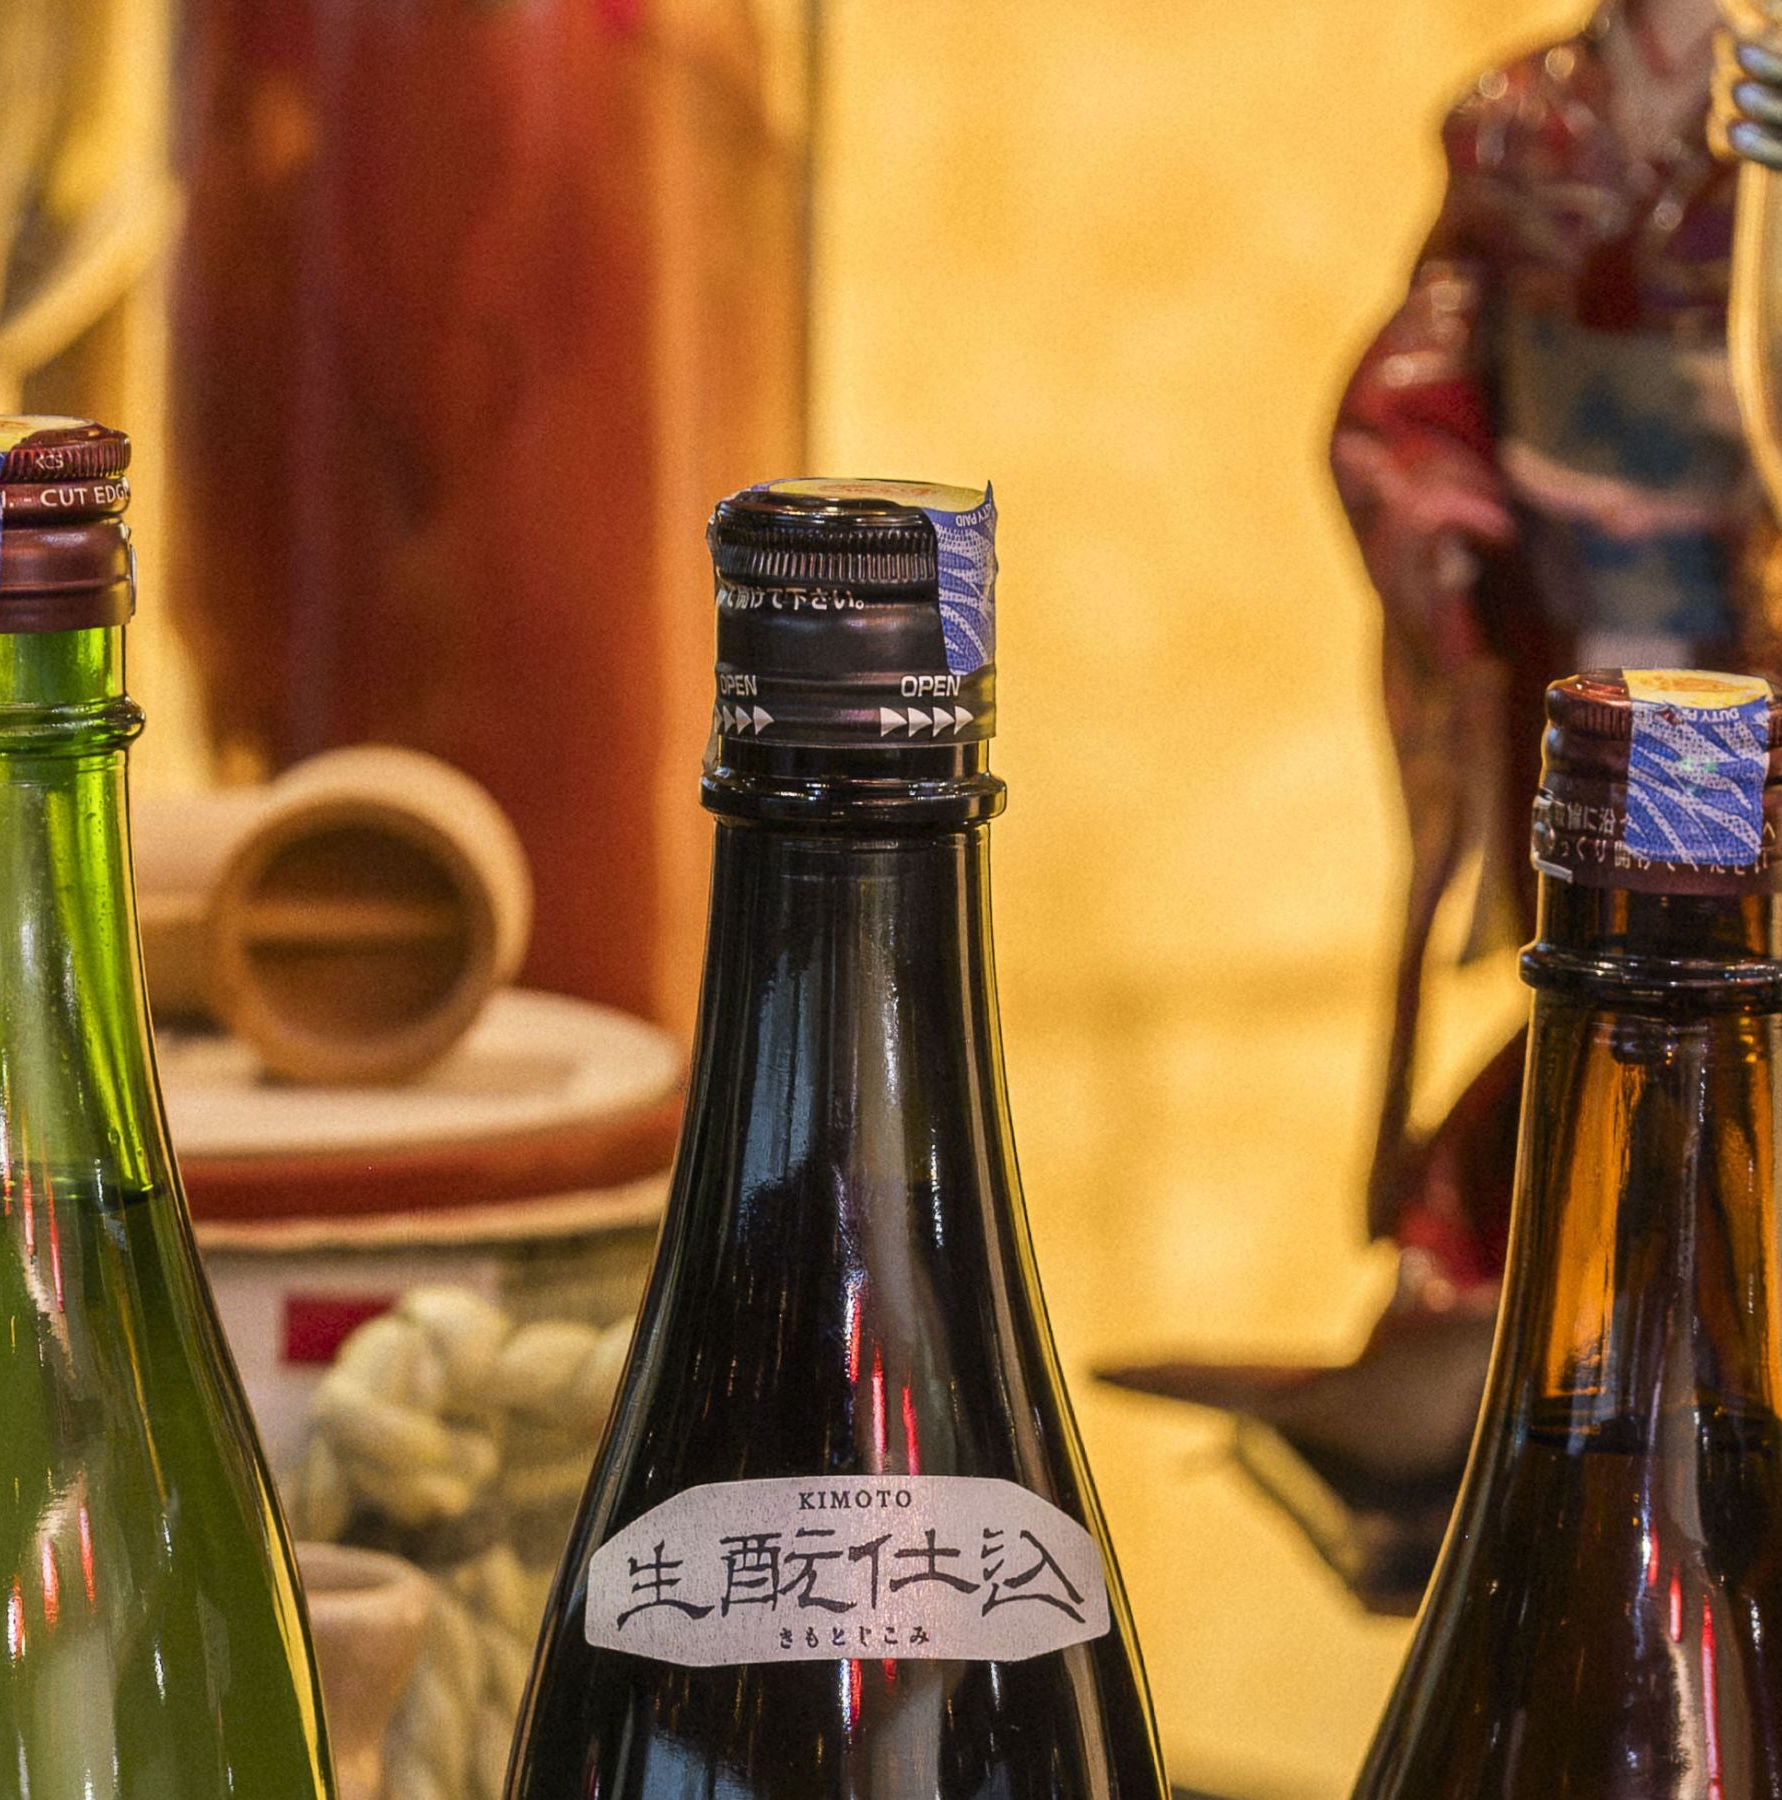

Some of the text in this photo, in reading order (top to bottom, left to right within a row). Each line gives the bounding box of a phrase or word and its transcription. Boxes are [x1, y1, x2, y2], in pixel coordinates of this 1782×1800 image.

[40, 487, 87, 508] CUT
[720, 674, 758, 697] OPEN
[900, 675, 962, 698] OPEN
[797, 1489, 913, 1511] KIMOTO
[778, 1625, 932, 1650] きもとじこみ
